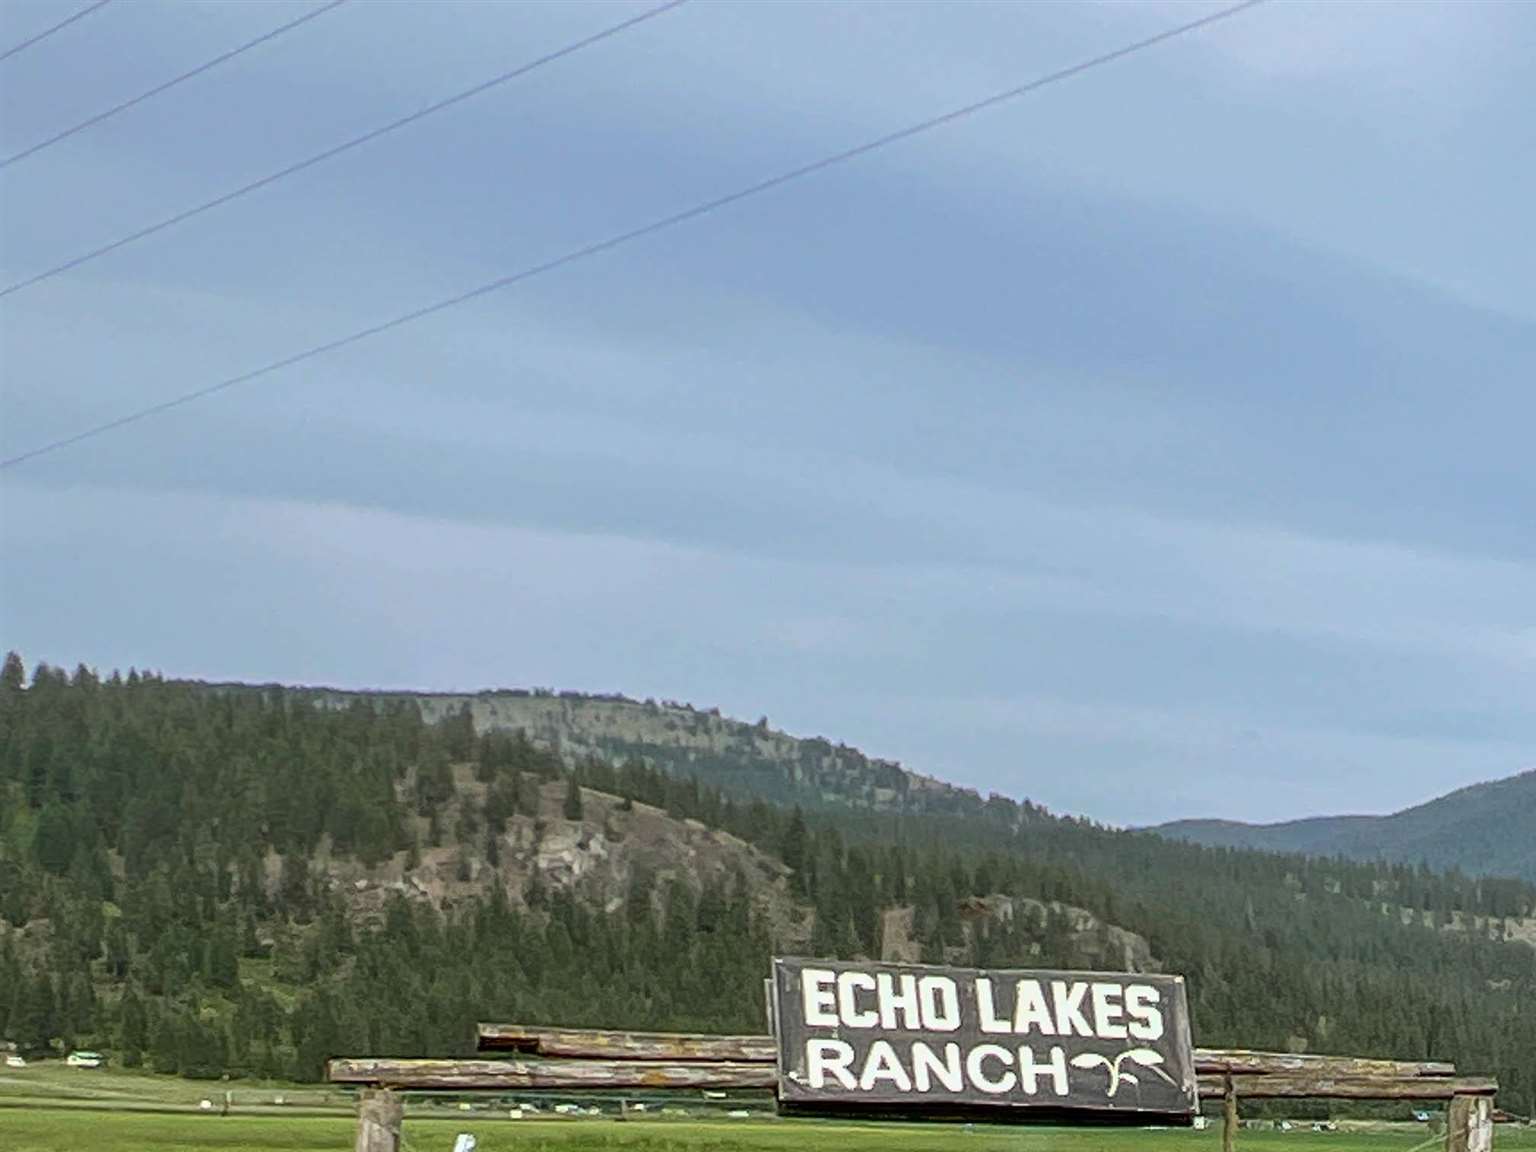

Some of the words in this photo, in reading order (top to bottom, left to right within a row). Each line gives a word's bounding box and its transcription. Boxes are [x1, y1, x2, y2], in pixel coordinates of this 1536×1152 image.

[801, 968, 962, 1032] ECHO
[975, 976, 1164, 1041] LAKES
[805, 1038, 1070, 1096] RANCH
